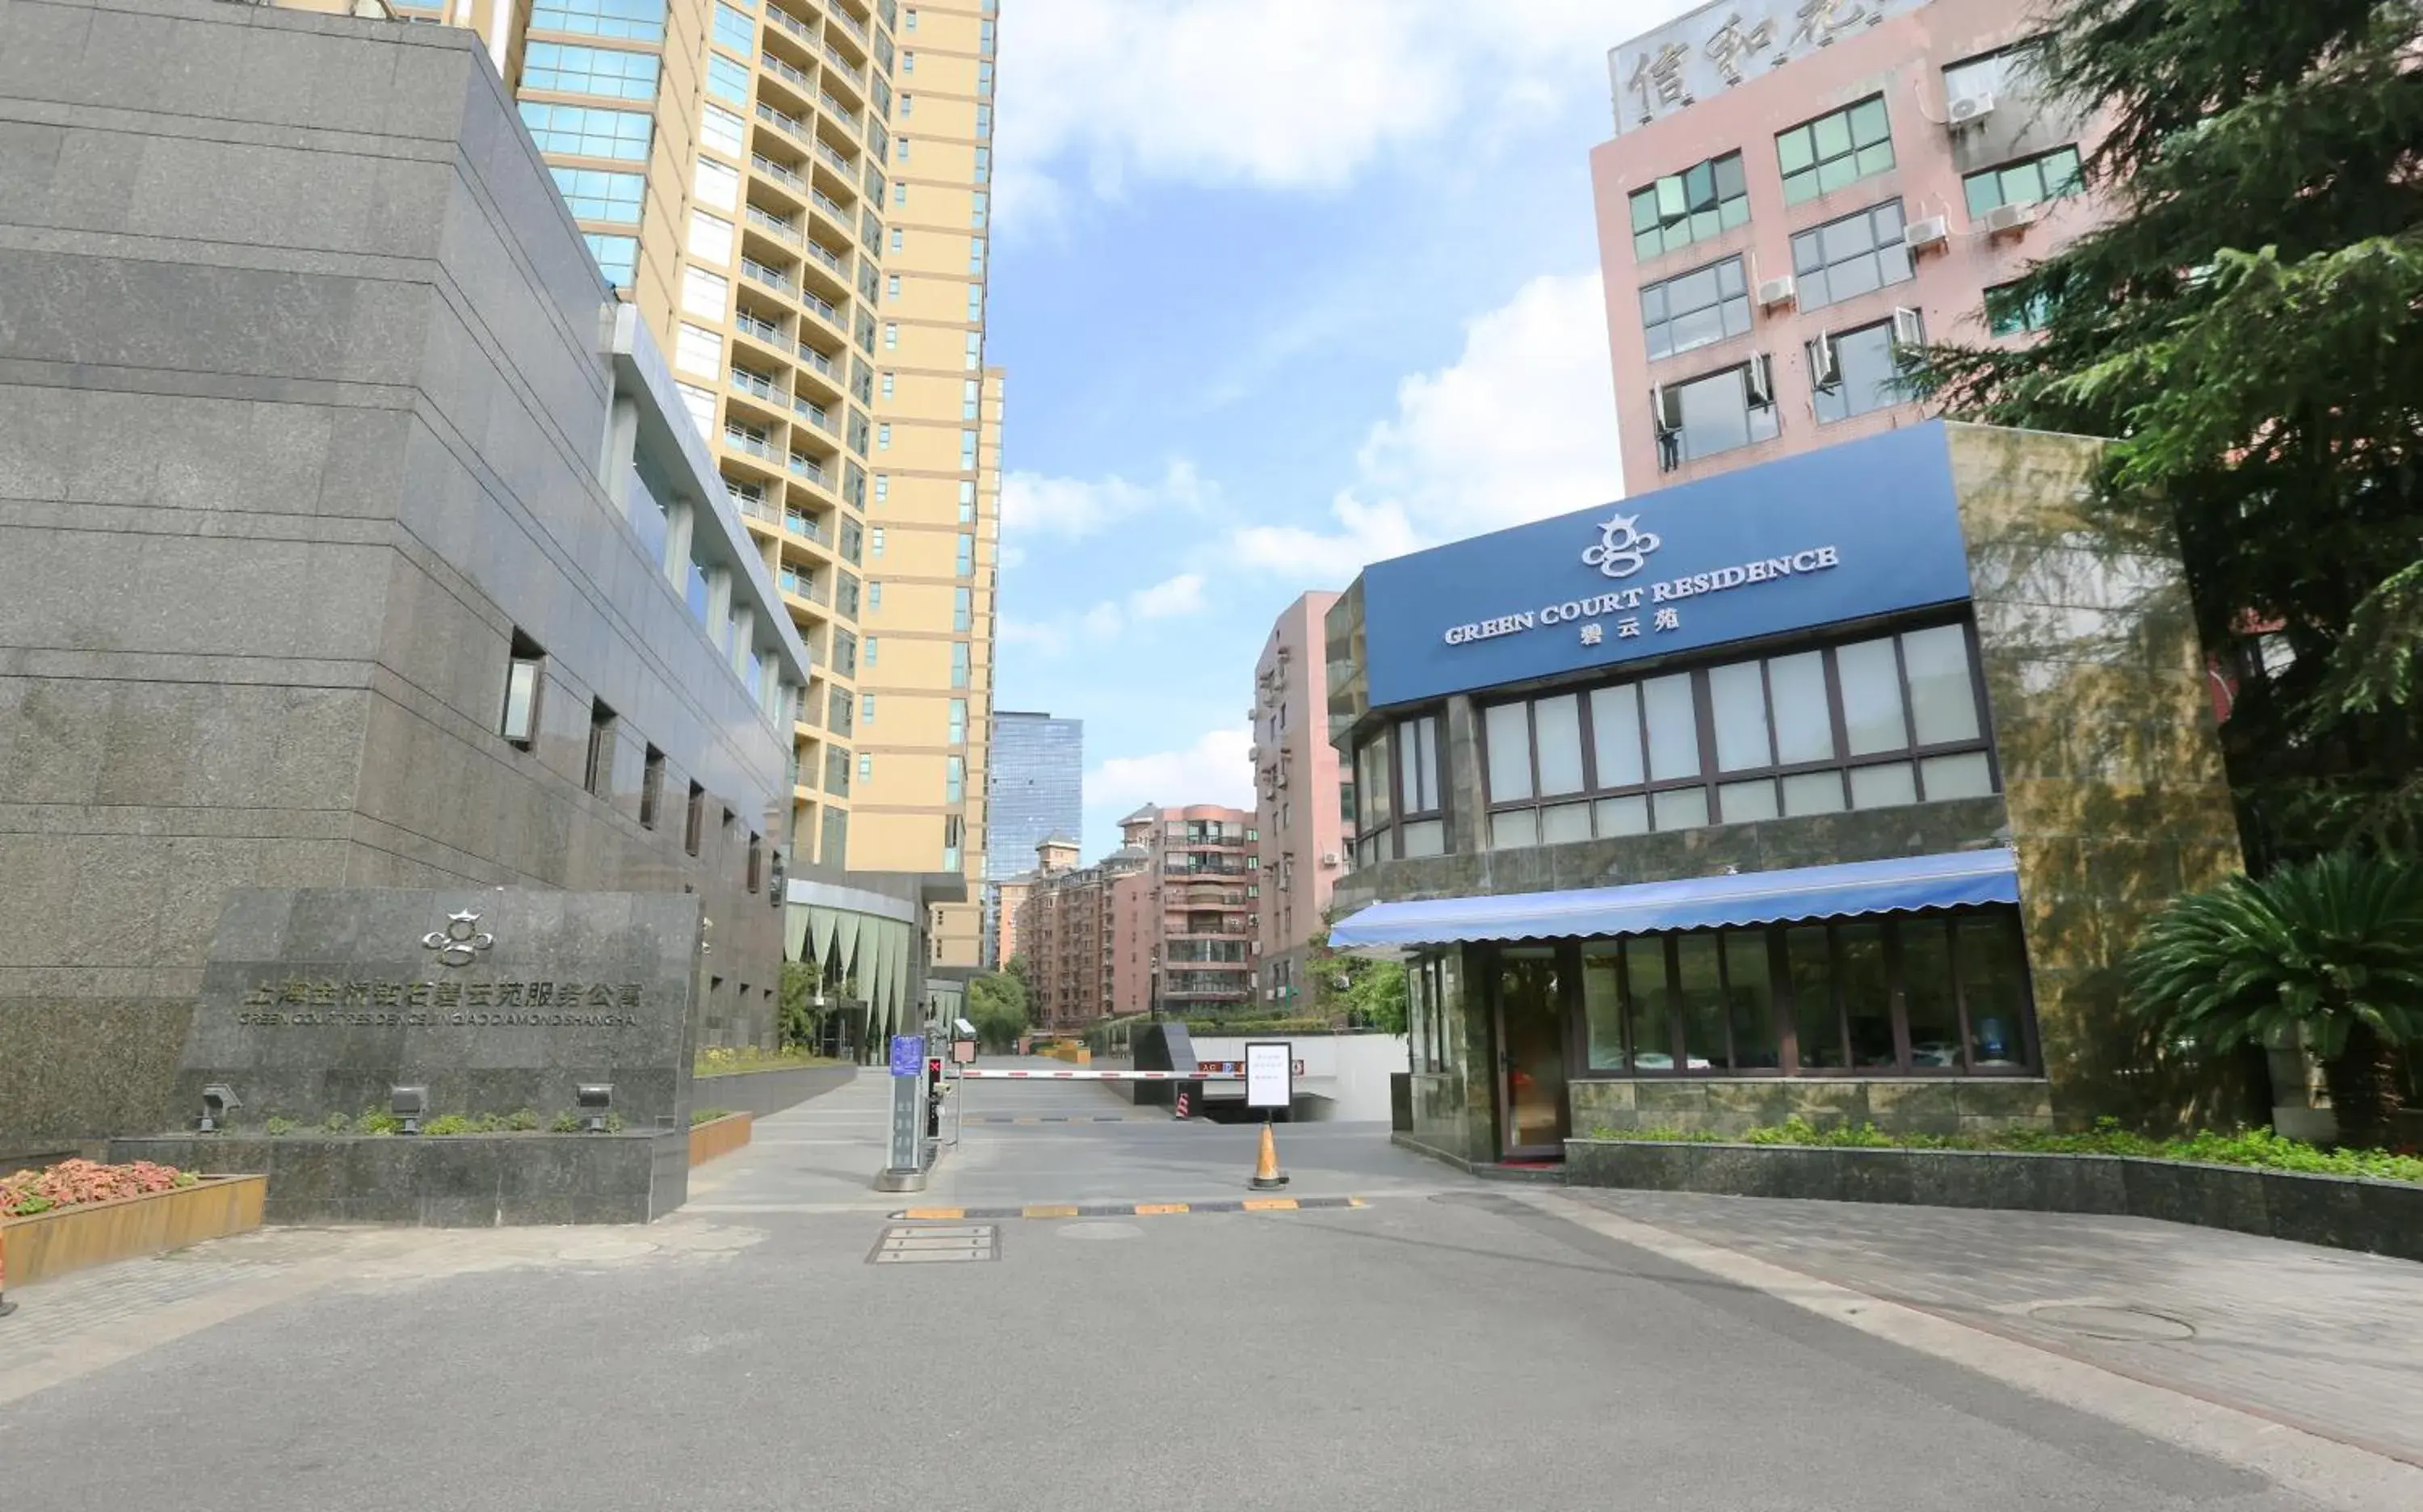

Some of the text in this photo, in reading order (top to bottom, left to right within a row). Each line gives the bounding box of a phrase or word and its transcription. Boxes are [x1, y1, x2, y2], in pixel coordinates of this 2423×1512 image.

[1445, 545, 1840, 646] GREEN COURT RESIDENCE
[1580, 607, 1679, 646] 碧云苑
